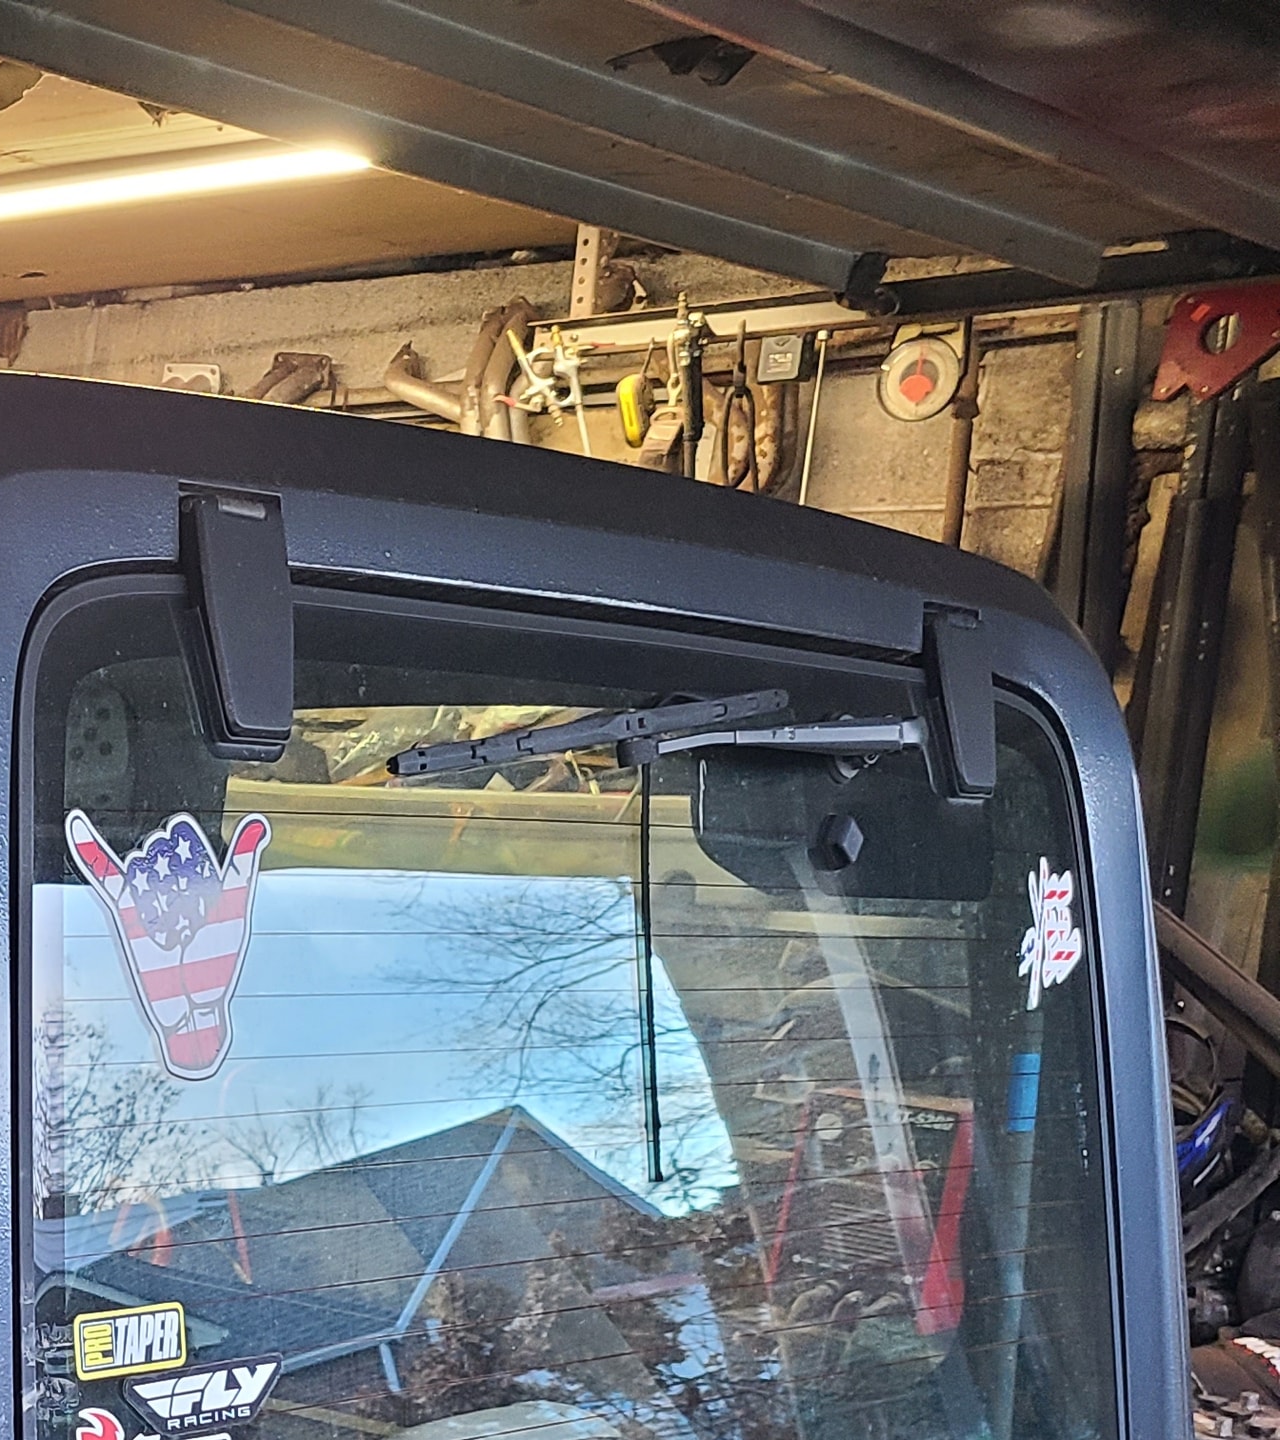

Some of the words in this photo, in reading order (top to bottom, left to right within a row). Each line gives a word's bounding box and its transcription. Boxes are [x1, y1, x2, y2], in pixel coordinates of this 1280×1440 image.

[83, 1323, 114, 1367] PRO
[114, 1310, 179, 1366] TAPER
[132, 1362, 278, 1419] FLY
[167, 1405, 252, 1431] RACING
